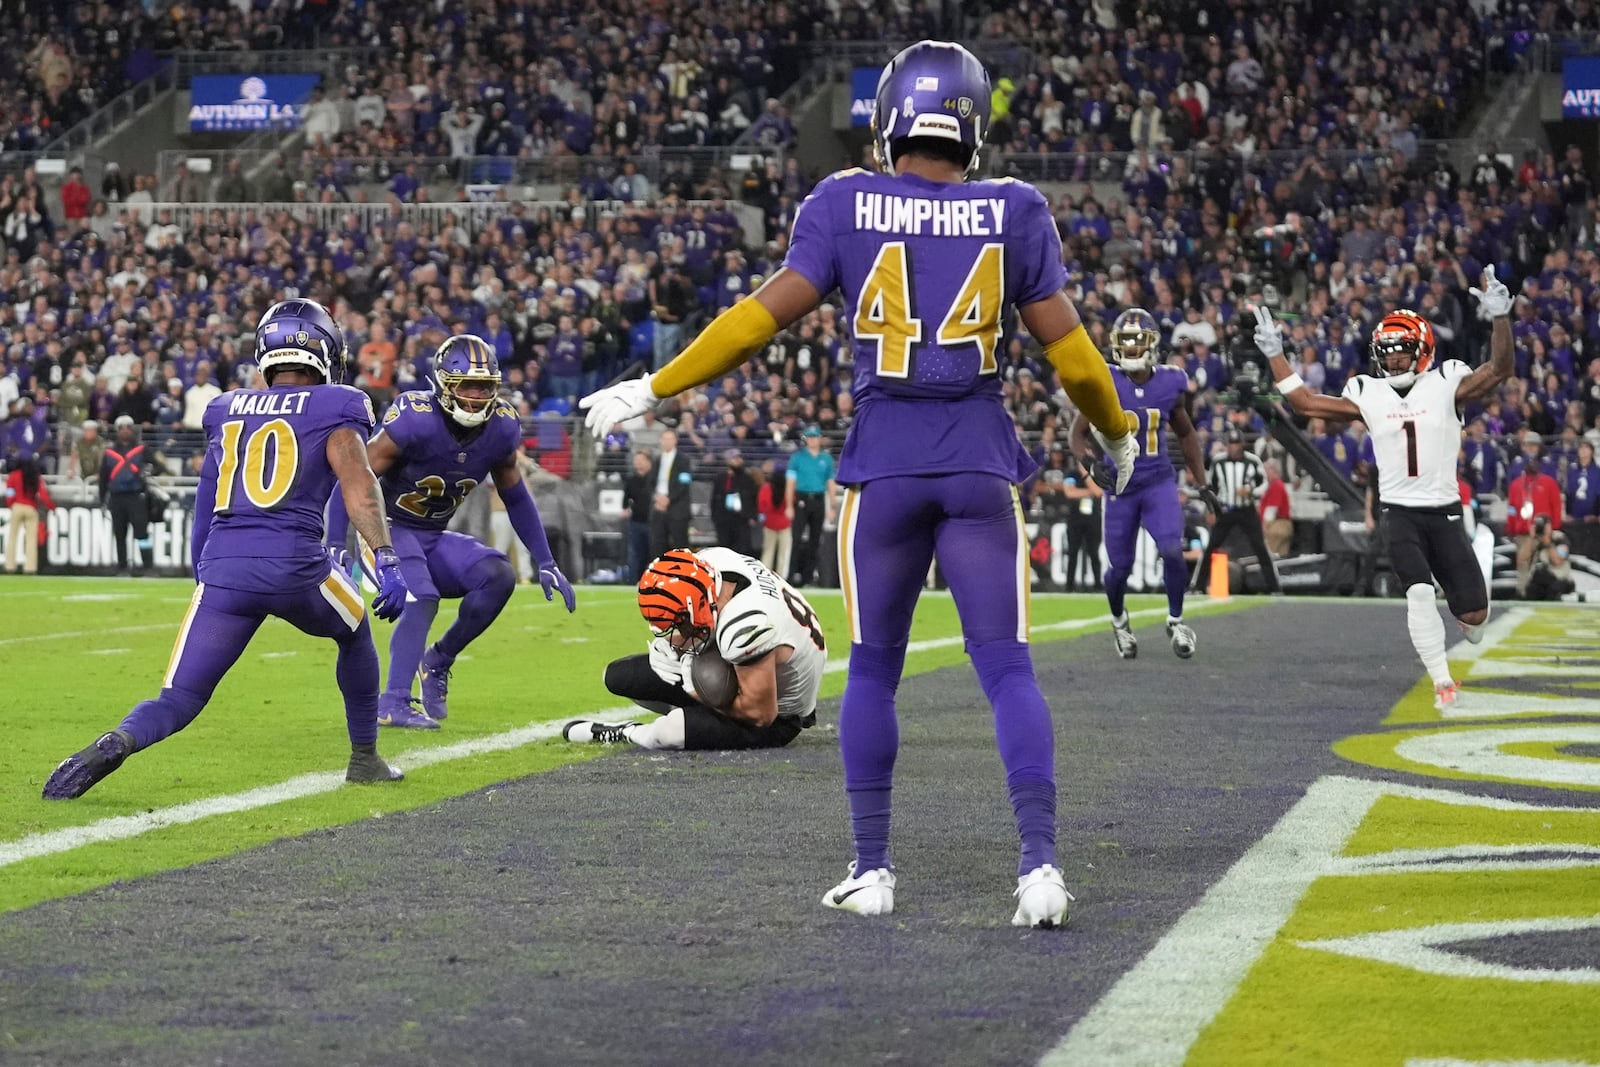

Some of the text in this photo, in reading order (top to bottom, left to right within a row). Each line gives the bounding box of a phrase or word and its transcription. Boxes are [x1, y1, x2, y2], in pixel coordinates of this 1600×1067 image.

[189, 104, 268, 119] AUTUMN
[943, 98, 956, 109] 44
[919, 121, 958, 132] RAVENS
[855, 191, 1006, 236] HUMPHREY
[853, 241, 1005, 378] 44
[285, 335, 294, 344] 10
[229, 392, 311, 415] MAULET
[1402, 421, 1418, 477] 1
[213, 418, 298, 513] 10
